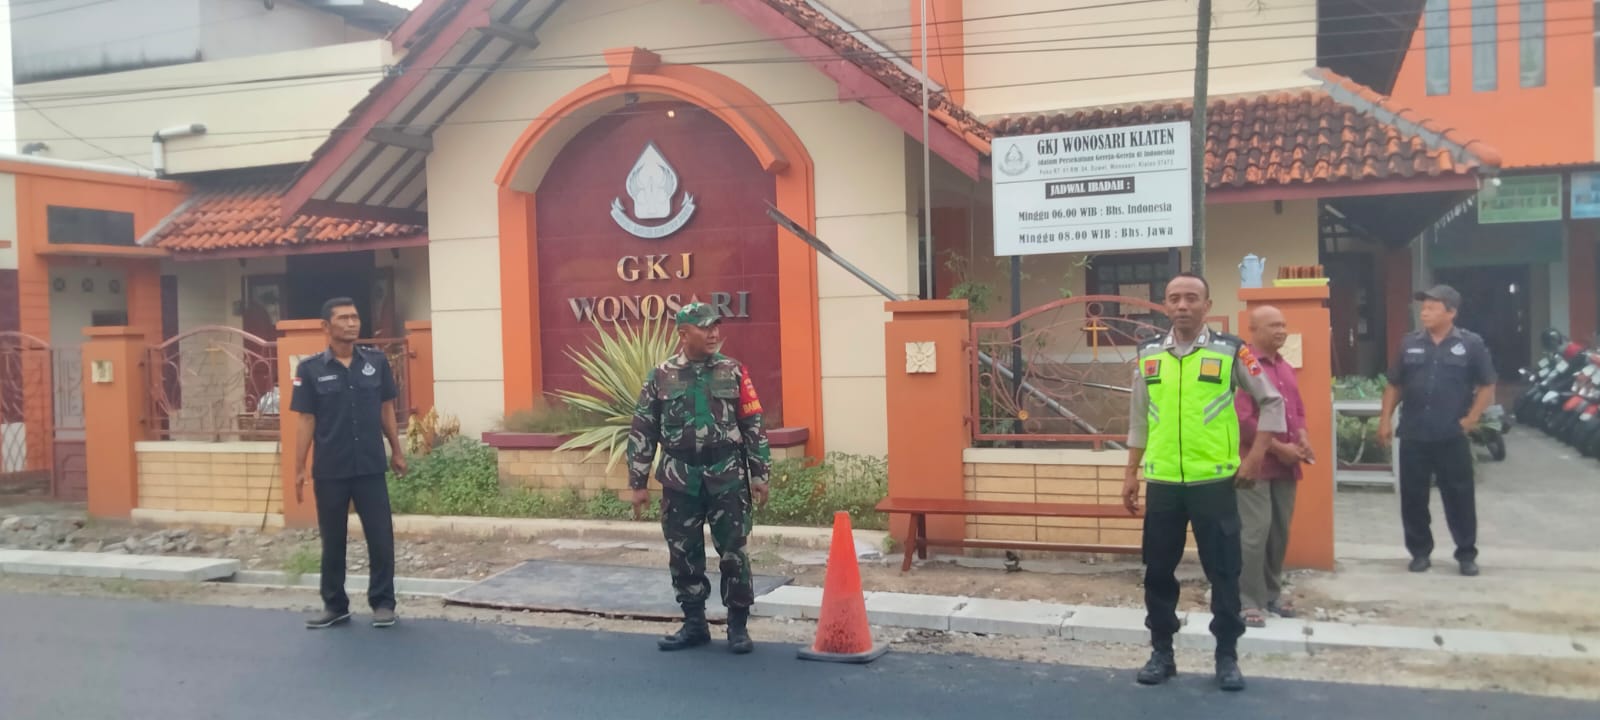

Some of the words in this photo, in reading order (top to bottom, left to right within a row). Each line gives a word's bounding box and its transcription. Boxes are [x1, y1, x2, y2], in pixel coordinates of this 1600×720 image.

[1037, 138, 1058, 156] GKJ
[1063, 133, 1125, 152] WONOSARI
[1130, 127, 1174, 147] KLATEN
[1050, 183, 1086, 196] JADWAL
[1088, 180, 1124, 192] IBADAH
[1019, 210, 1049, 221] Minggu
[1052, 208, 1077, 219] 06.00
[1080, 207, 1098, 217] WIB
[1106, 205, 1124, 216] Bhs.
[1128, 202, 1172, 214] Indonesia
[1019, 232, 1055, 244] Minggu
[1058, 230, 1088, 241] 08.00
[1091, 229, 1111, 239] WIB
[1121, 227, 1143, 238] Bhs.
[1147, 226, 1173, 238] Jawa
[617, 252, 692, 281] GKJ
